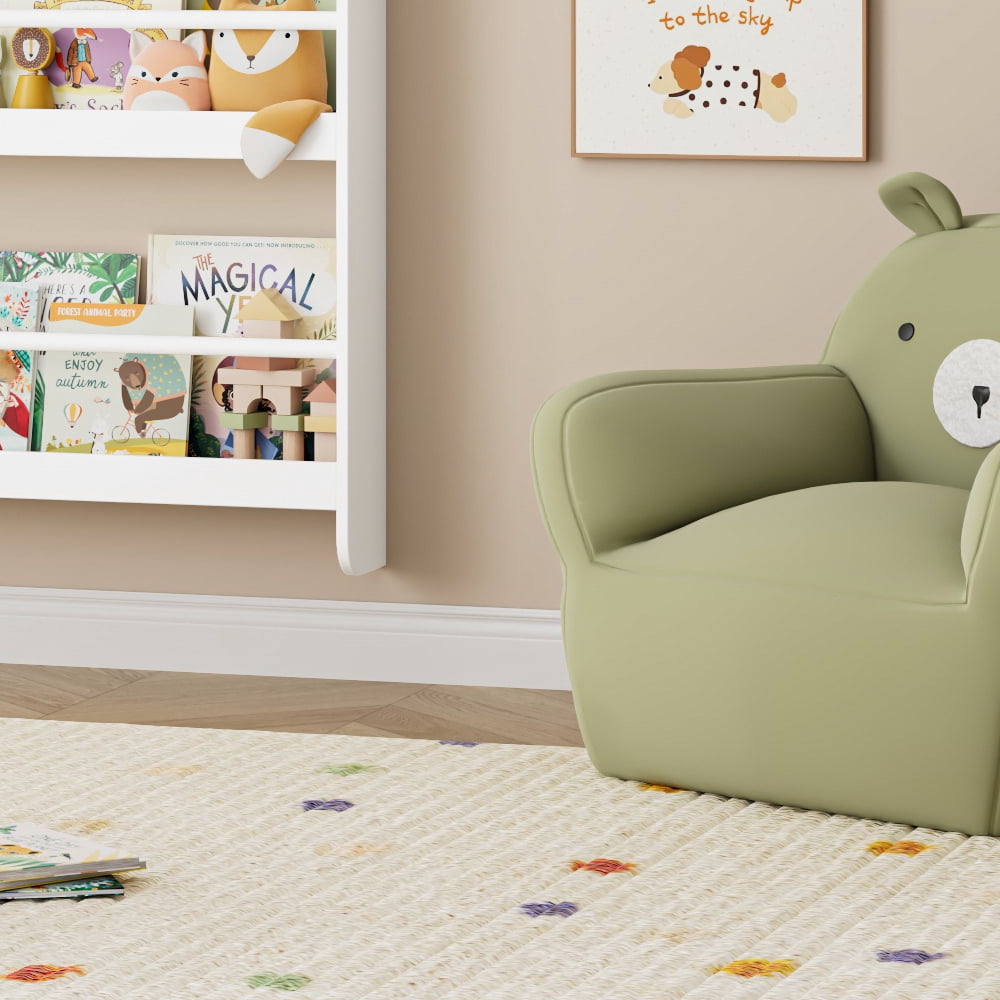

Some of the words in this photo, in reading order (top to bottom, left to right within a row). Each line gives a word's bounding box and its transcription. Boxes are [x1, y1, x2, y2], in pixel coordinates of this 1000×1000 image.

[658, 11, 686, 31] to
[691, 4, 730, 26] the
[737, 5, 774, 36] sky
[192, 252, 215, 271] THE
[181, 262, 316, 311] MAGICAL
[57, 306, 81, 317] FOREST
[83, 307, 113, 318] ANIMAL
[114, 308, 137, 318] PARTY
[64, 358, 104, 372] ENJOY
[55, 373, 109, 390] autumn
